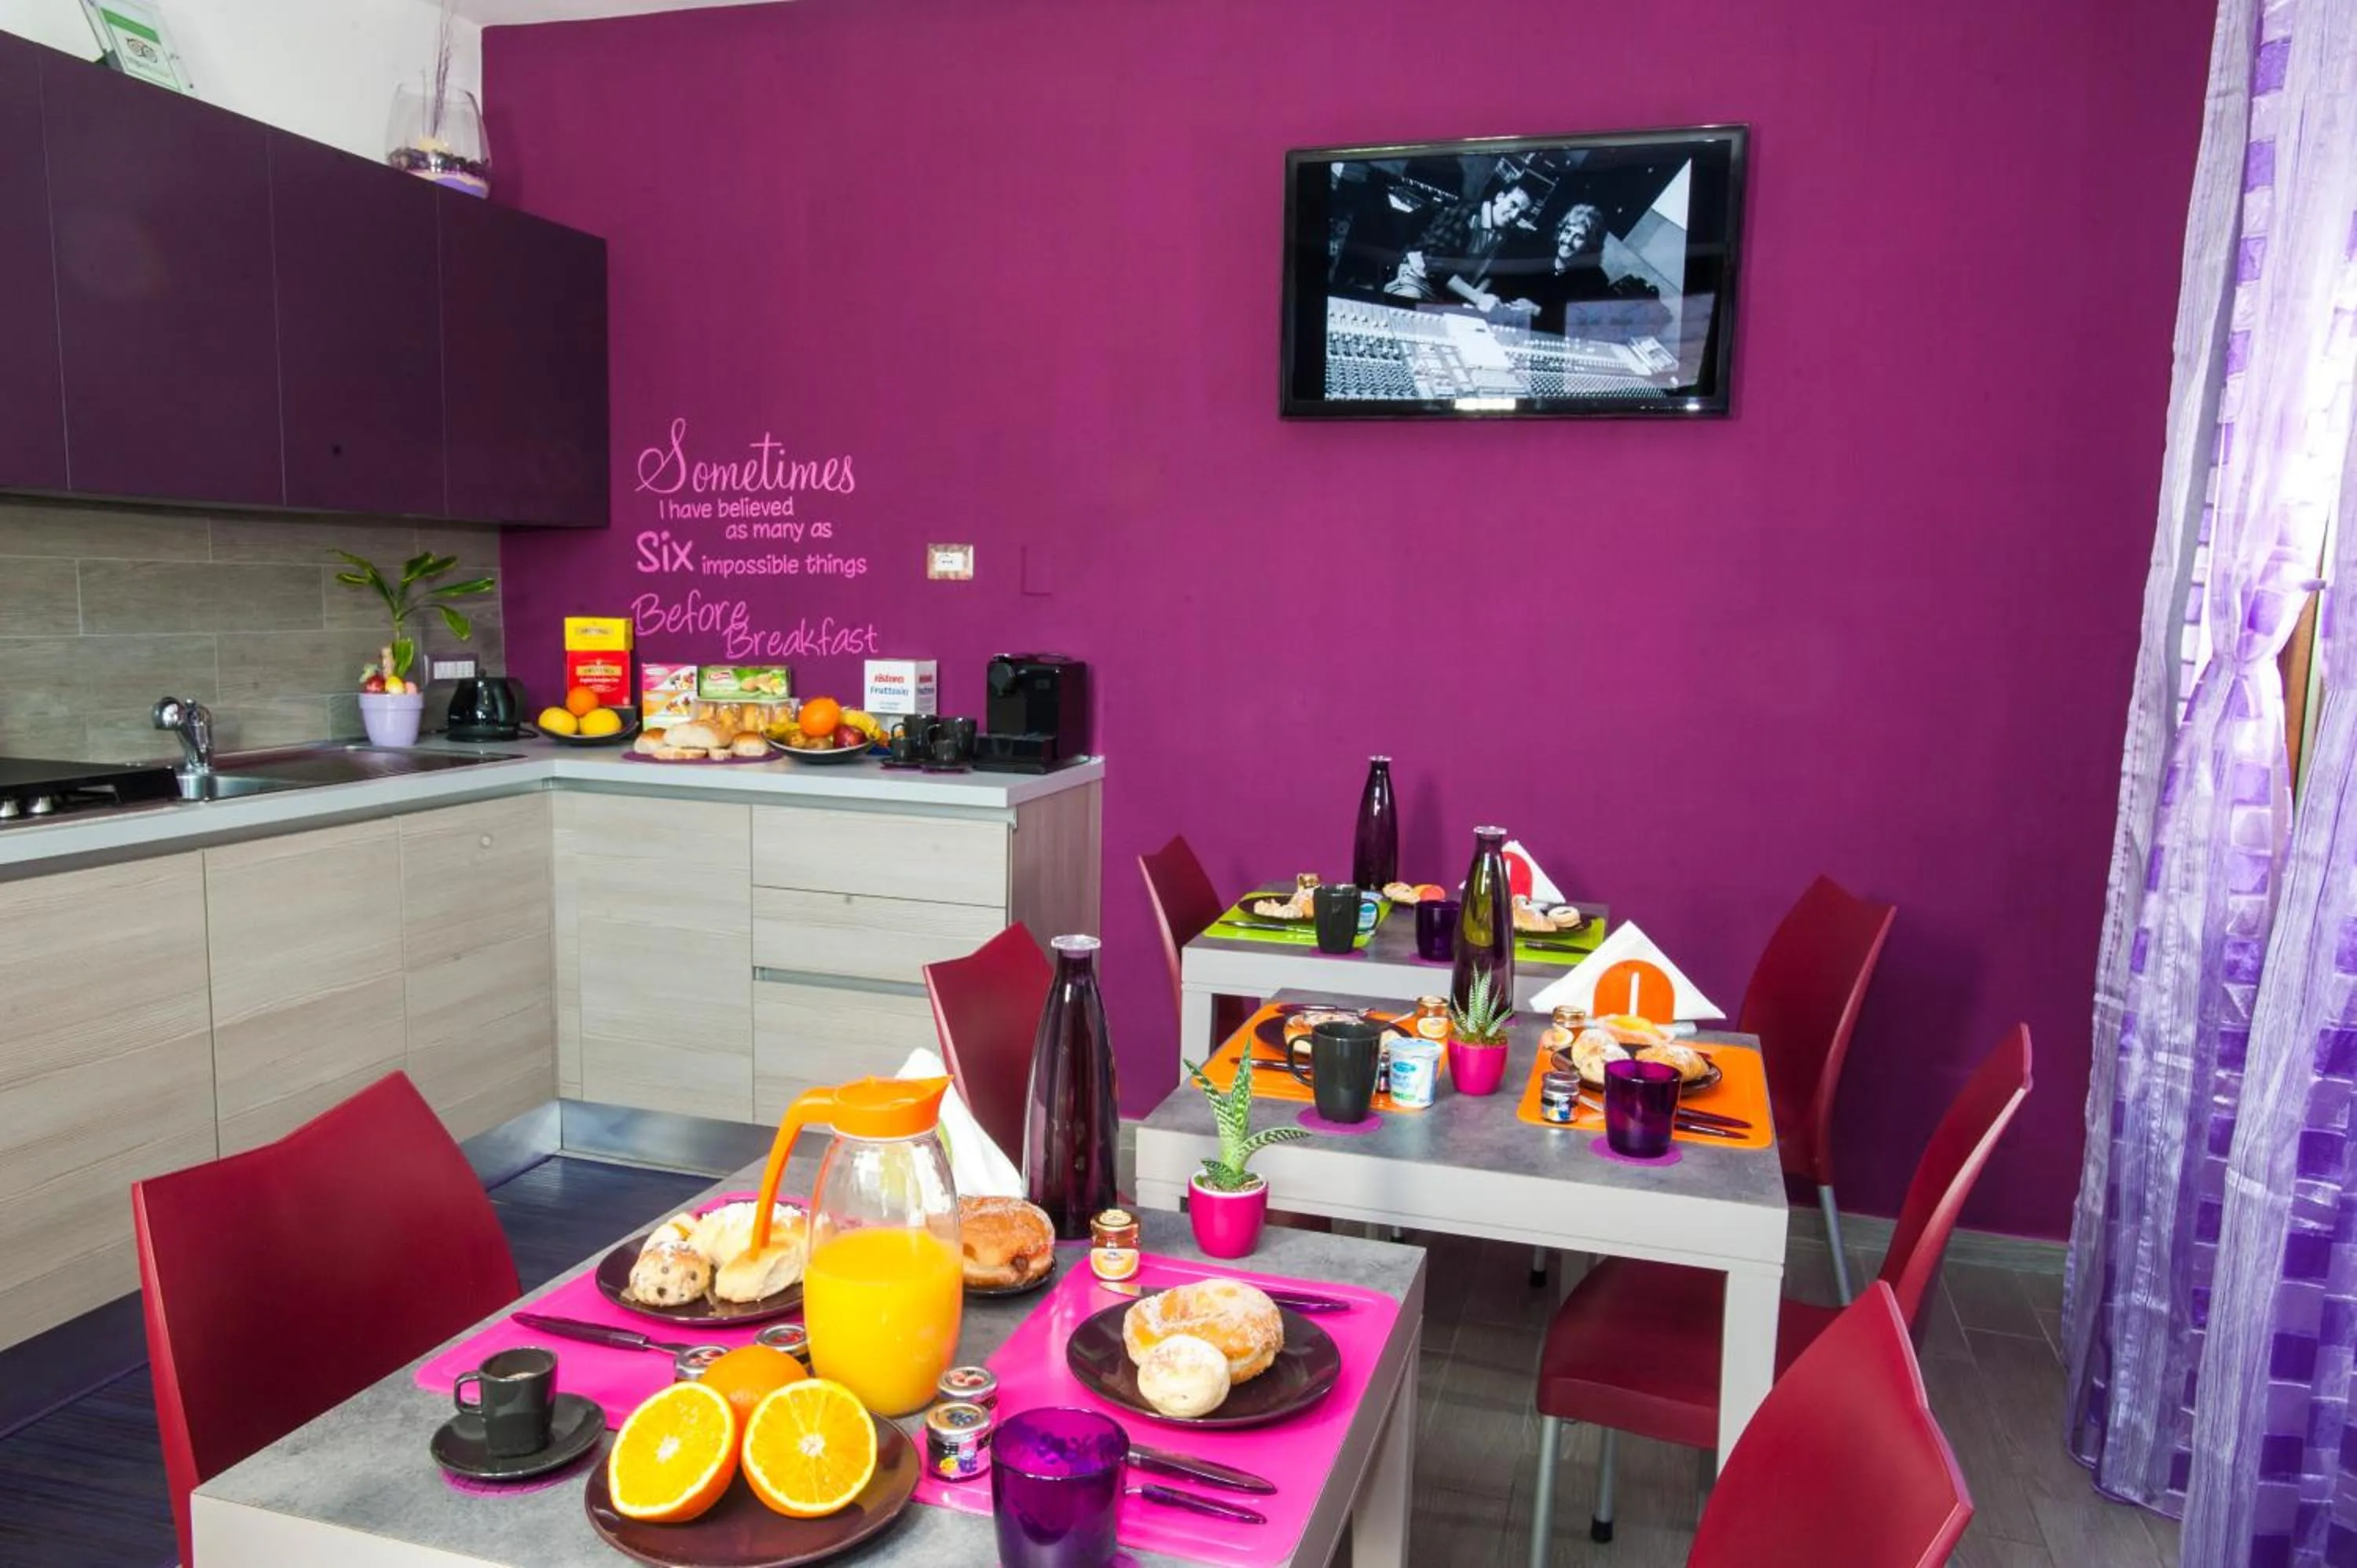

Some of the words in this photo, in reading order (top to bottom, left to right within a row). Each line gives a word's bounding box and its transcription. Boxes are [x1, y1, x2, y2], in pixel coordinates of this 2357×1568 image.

[634, 417, 857, 495] Sometimes
[658, 499, 665, 520] I
[669, 498, 712, 520] have
[717, 496, 794, 518] believed
[636, 530, 695, 573] Six
[701, 554, 800, 579] impossible
[805, 553, 868, 579] things
[724, 522, 748, 540] as
[753, 522, 805, 543] many
[810, 522, 833, 539] as
[630, 588, 750, 637] Before
[721, 616, 879, 660] Breakfast
